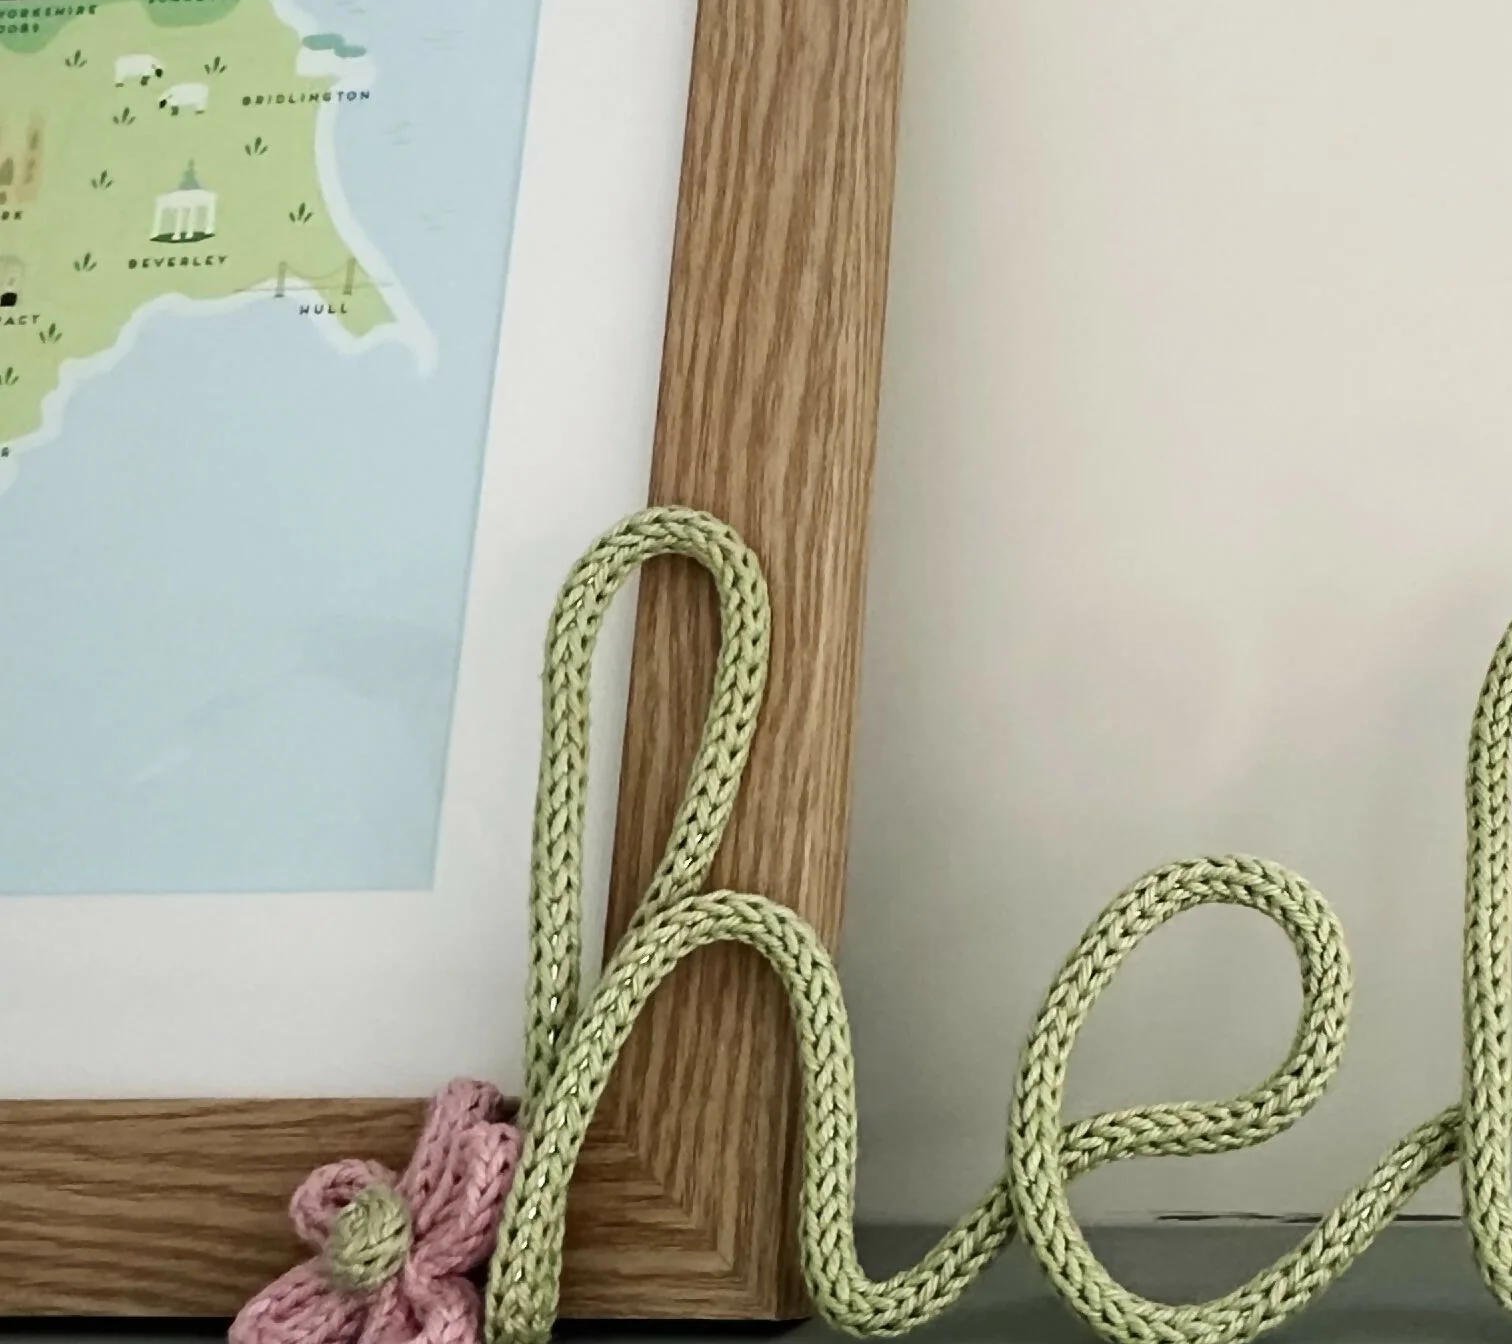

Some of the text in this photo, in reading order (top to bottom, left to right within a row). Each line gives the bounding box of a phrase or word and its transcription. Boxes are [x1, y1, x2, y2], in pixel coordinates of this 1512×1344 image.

[242, 90, 370, 106] BRIDLINGTON
[128, 255, 228, 269] BEVERLEY
[299, 303, 348, 315] HULL
